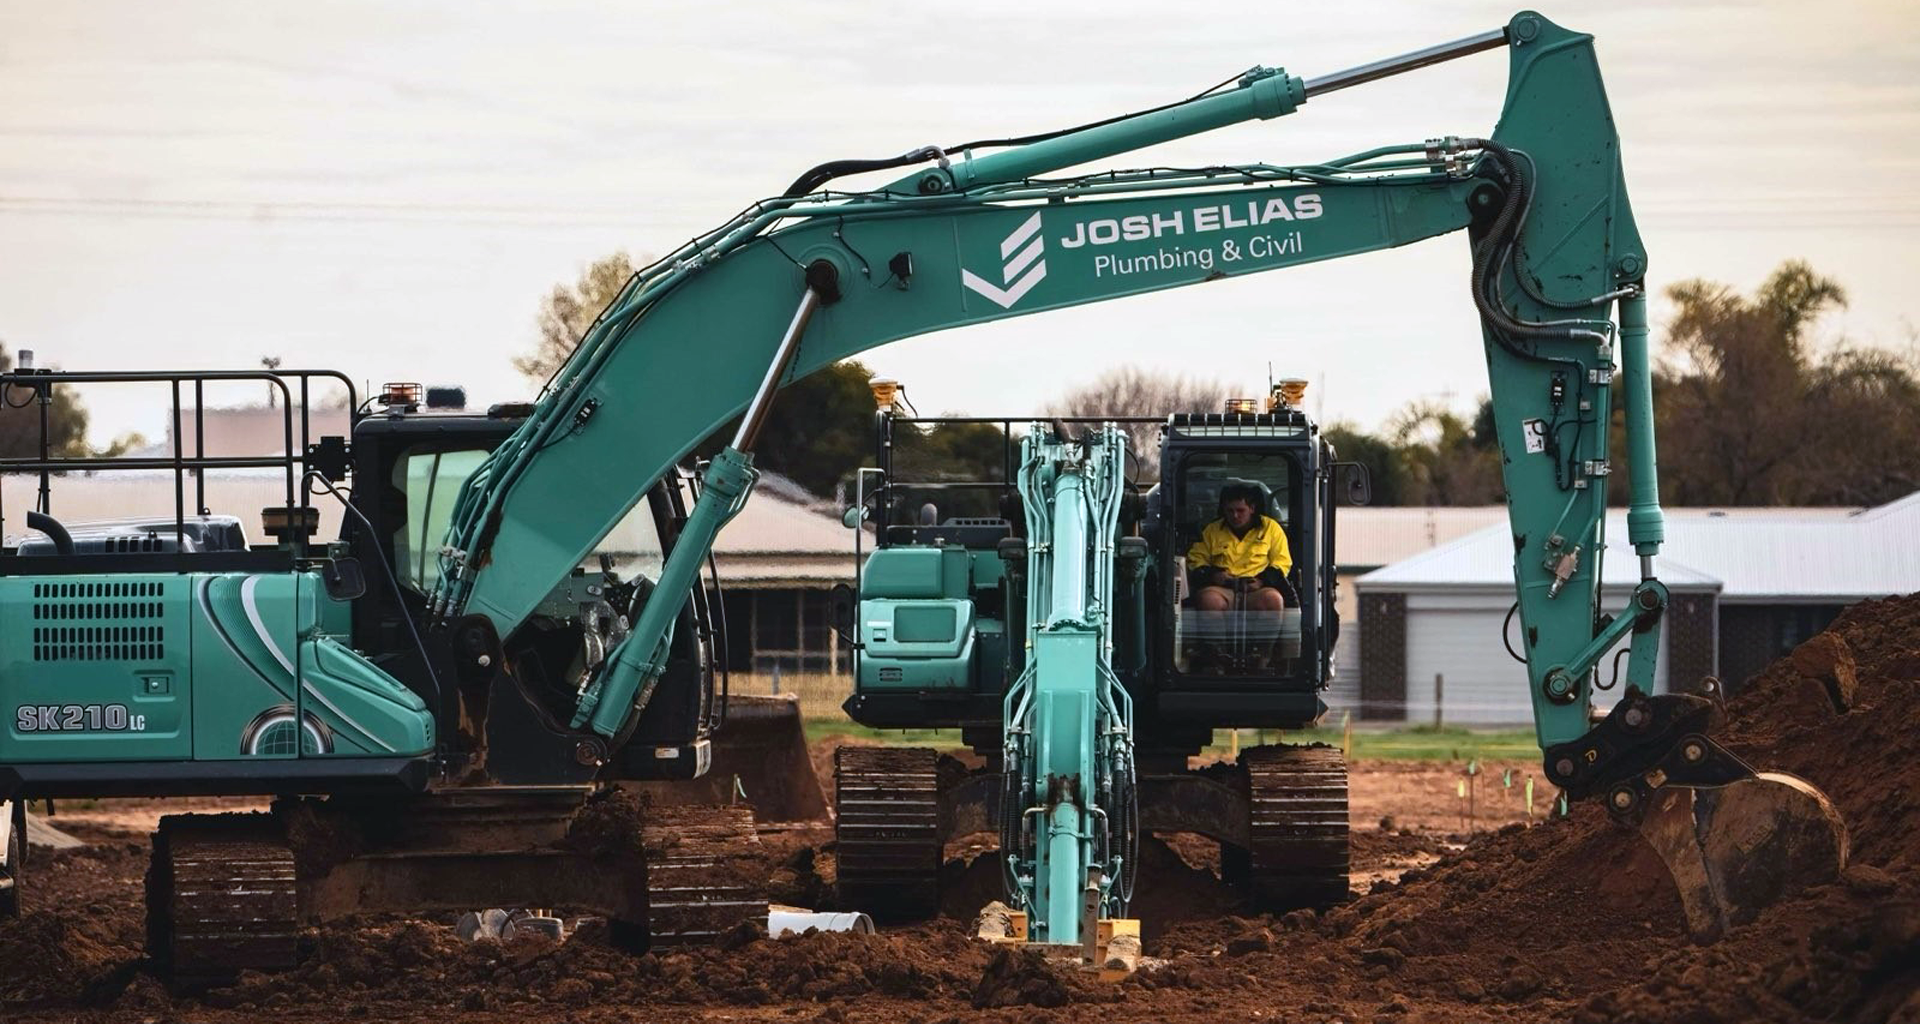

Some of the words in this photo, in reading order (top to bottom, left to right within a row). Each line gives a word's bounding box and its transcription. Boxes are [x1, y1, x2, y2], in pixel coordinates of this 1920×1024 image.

[1061, 211, 1184, 248] JOSH
[1193, 194, 1324, 232] ELIAS
[1094, 247, 1214, 277] Plumbing
[1221, 239, 1242, 262] &
[1249, 232, 1302, 259] Civil
[17, 704, 127, 731] SK210
[129, 714, 146, 731] LC
